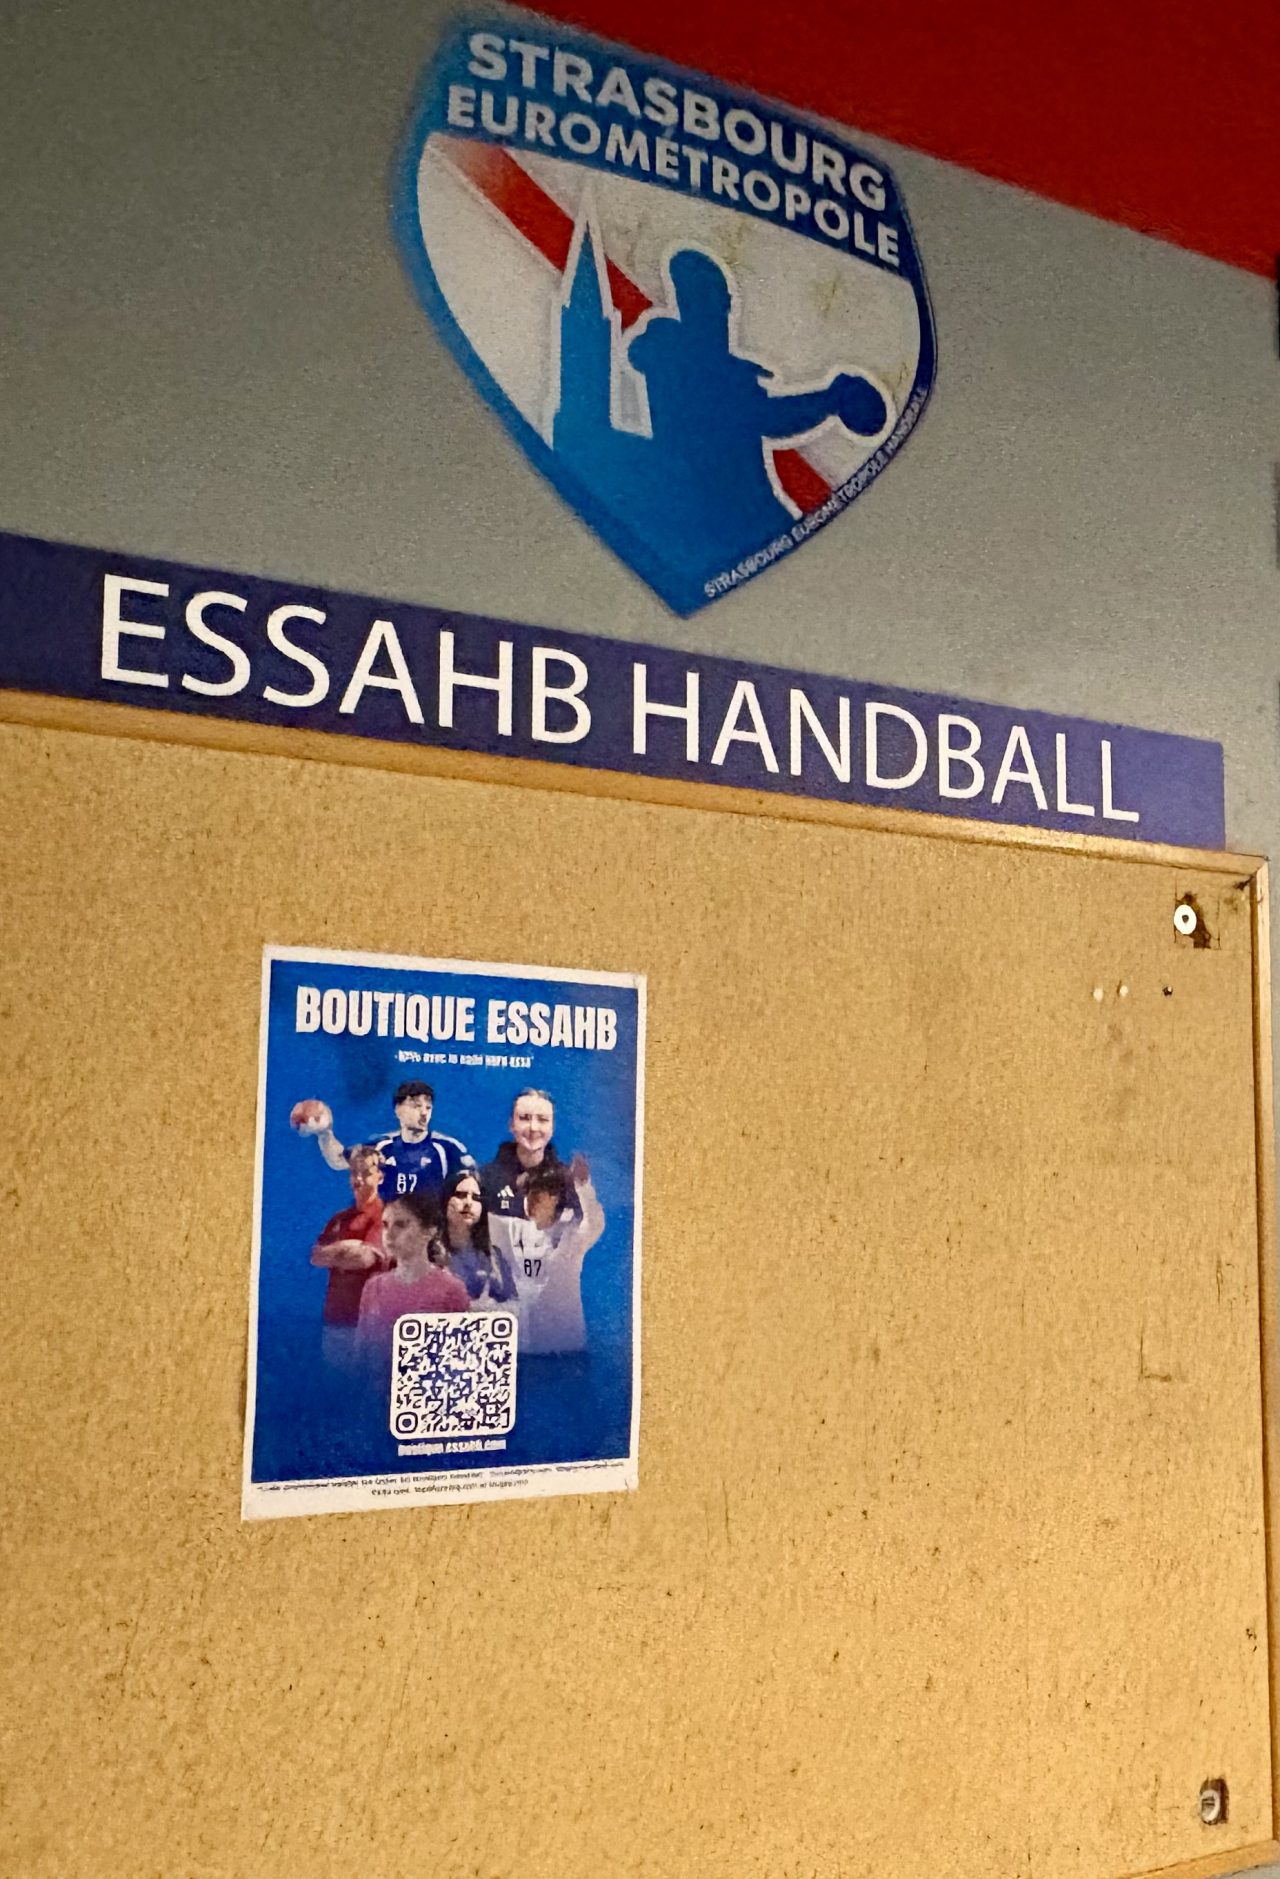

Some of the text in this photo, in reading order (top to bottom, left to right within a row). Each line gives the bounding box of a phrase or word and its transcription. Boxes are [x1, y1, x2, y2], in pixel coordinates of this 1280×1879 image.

[447, 84, 900, 266] EUROMÉTROPOLE
[467, 33, 887, 212] STRASBOURG
[100, 573, 1140, 824] ESSAHB HANDBALL
[296, 985, 618, 1051] BOUTIQUE ESSAHB
